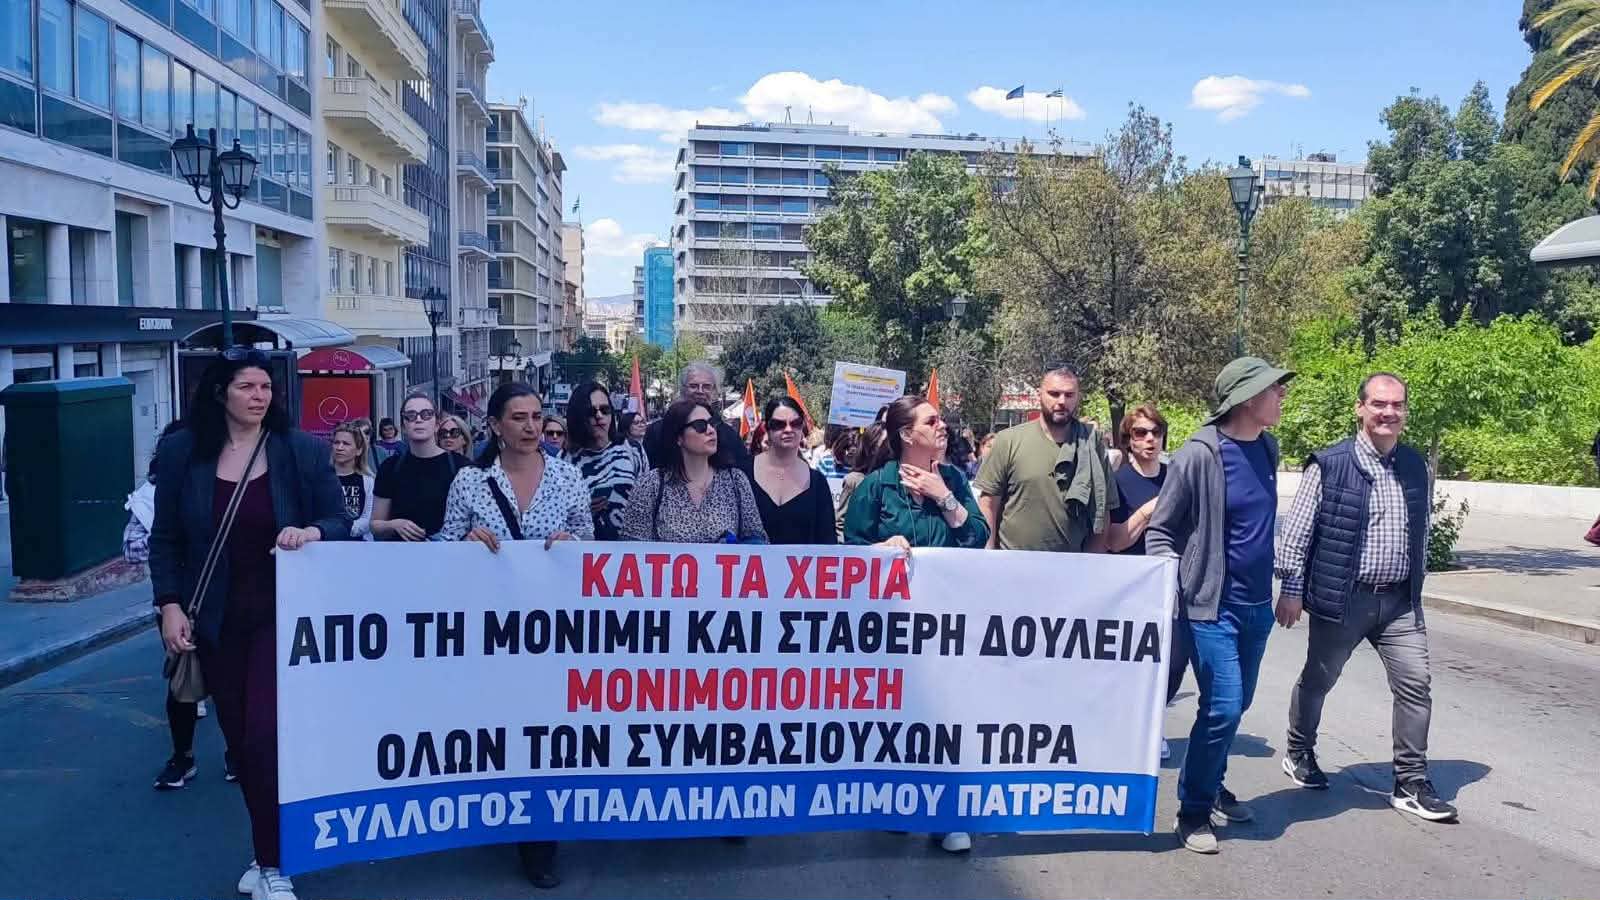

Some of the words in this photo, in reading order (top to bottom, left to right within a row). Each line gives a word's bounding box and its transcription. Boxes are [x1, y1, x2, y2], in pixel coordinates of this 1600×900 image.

[582, 553, 699, 598] ΚΑΤΩ
[716, 554, 769, 599] ΤΑ
[786, 555, 912, 600] ΧΕΡΙΑ
[288, 613, 388, 667] ΑΠΟ
[405, 611, 465, 658] ΤΗ
[483, 609, 671, 656] ΜΟΝΙΜΗ
[687, 610, 763, 654] ΚΑΙ
[777, 611, 966, 657] ΣΤΑΘΕΡΗ
[979, 615, 1162, 664] ΔΟΥΛΕΙΑ
[567, 667, 904, 712] ΜΟΝΙΜΟΠΟΙΗΣΗ
[376, 727, 506, 780] ΟΛΩΝ
[522, 724, 611, 769] ΤΩΝ
[626, 721, 963, 768] ΣΥΜΒΑΣΙΟΥΧΩΝ
[976, 723, 1078, 765] ΤΩΡΑ
[313, 790, 532, 849] ΣΥΛΛΟΓΟΣ
[545, 784, 797, 823] ΥΠΑΛΛΗΛΩΝ
[807, 783, 947, 817] ΔΗΜΟΥ
[956, 782, 1129, 817] ΠΑΤΡΕΩΝ
